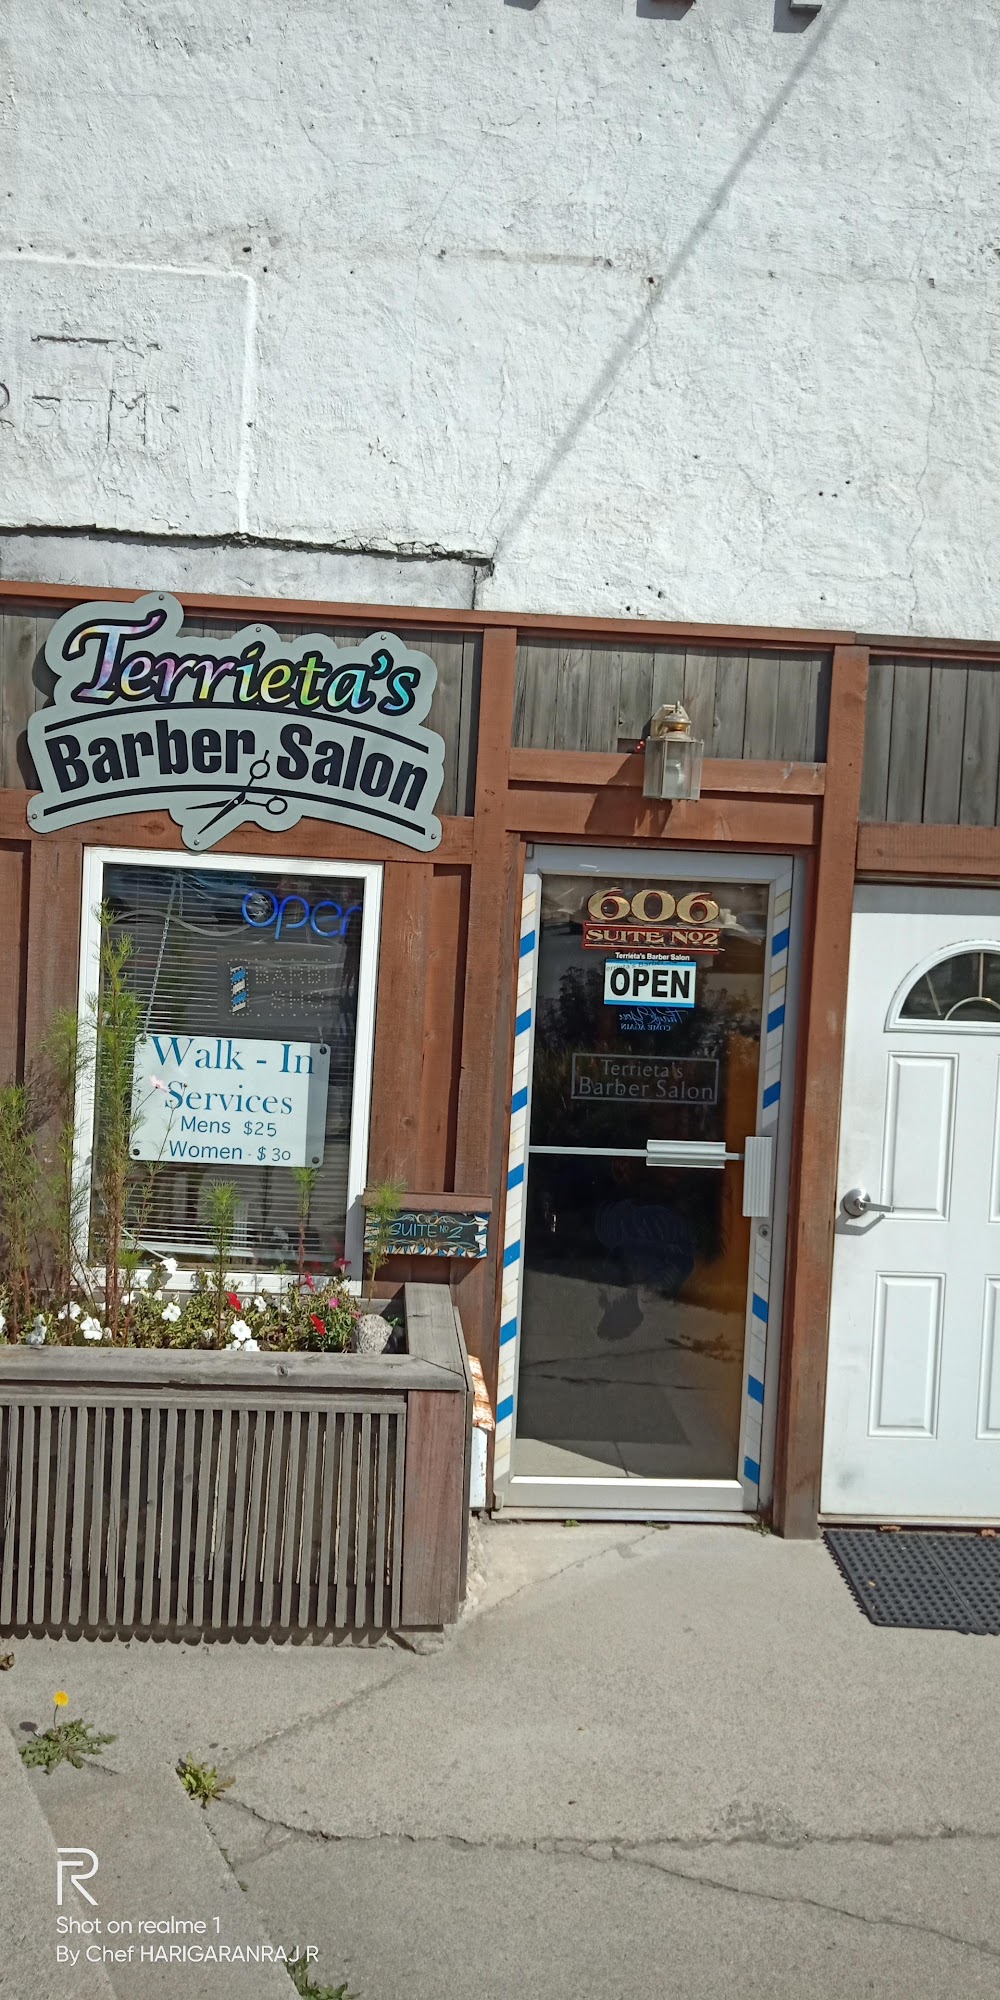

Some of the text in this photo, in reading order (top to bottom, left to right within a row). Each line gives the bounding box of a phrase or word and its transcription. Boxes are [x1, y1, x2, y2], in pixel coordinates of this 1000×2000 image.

[63, 609, 420, 715] Terrieta's
[44, 719, 428, 811] Barber Salon
[587, 887, 720, 924] 606
[585, 929, 664, 943] SUITE
[615, 951, 646, 960] Terrieta's
[670, 953, 690, 961] Salon
[610, 967, 690, 998] OPEN
[152, 1036, 244, 1070] Walk
[278, 1043, 314, 1074] In
[601, 1059, 683, 1079] Terrieta's
[165, 1080, 293, 1115] Services
[579, 1076, 713, 1100] Barber Salon
[181, 1116, 277, 1138] Mens $25
[169, 1140, 242, 1160] Women
[389, 1222, 437, 1238] SUITE
